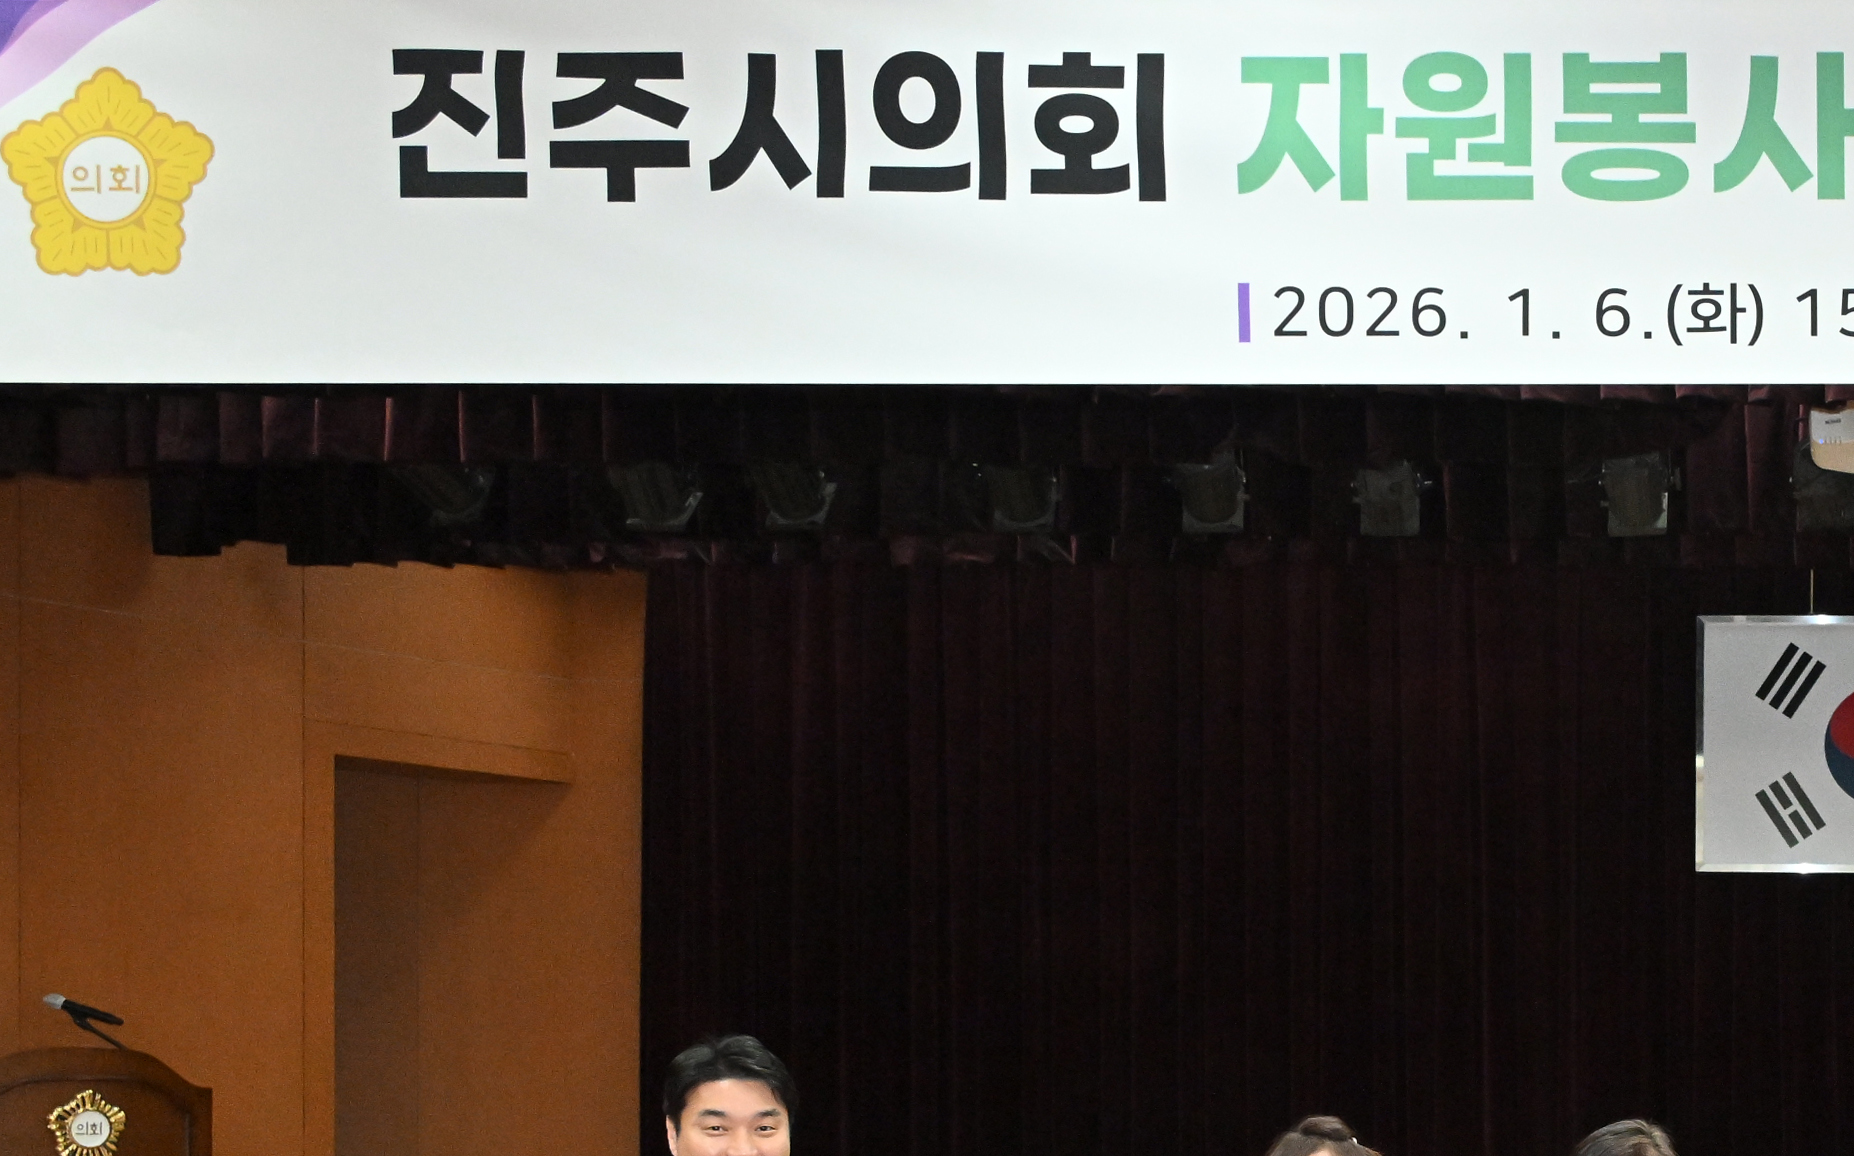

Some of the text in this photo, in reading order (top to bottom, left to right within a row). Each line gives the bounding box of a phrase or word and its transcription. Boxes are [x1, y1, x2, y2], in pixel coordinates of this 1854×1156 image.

[391, 48, 1167, 203] 진주시의회
[70, 164, 141, 194] 의회
[1273, 285, 1469, 340] 2026.
[1508, 288, 1561, 340] 1.
[75, 1121, 103, 1136] 의회
